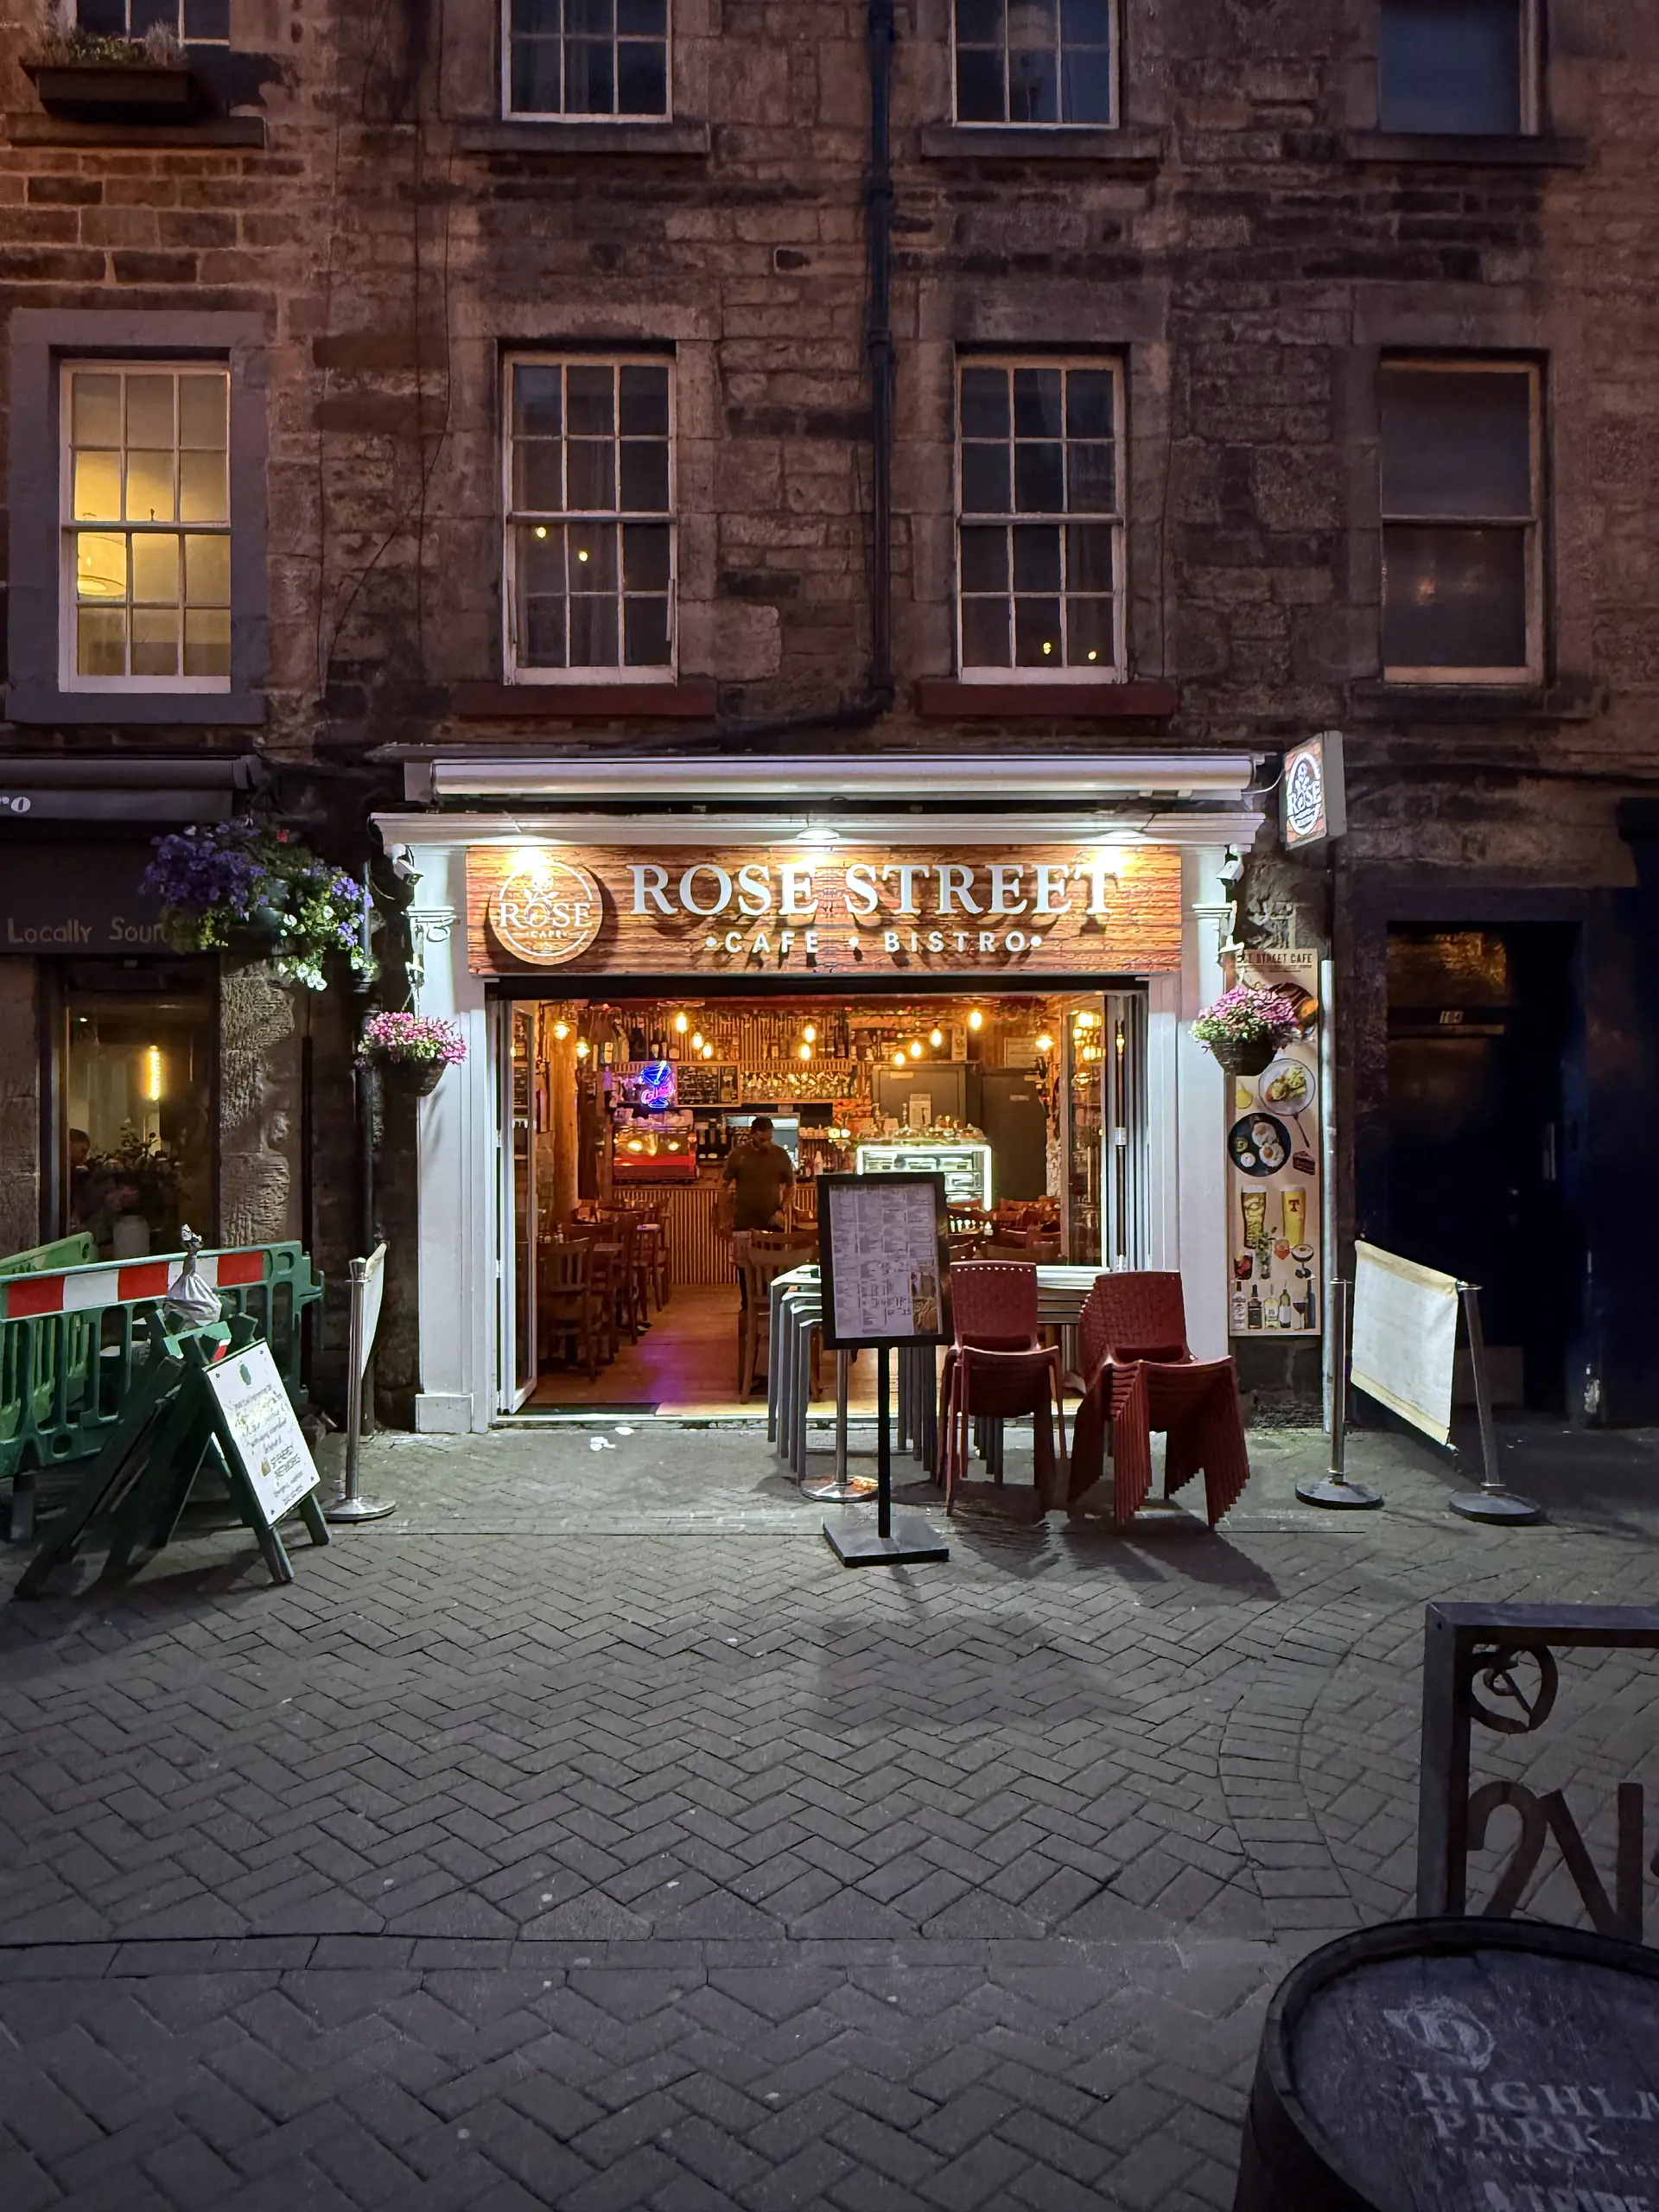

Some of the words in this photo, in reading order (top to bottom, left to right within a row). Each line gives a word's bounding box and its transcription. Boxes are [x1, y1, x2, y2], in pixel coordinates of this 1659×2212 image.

[1287, 780, 1323, 817] ROSE
[628, 863, 819, 916] ROSE
[844, 863, 1118, 915] STREET
[499, 902, 593, 929] ROSE
[7, 917, 92, 944] Locally
[725, 931, 819, 953] CAFE
[883, 931, 1026, 952] BISTRO
[1288, 1198, 1300, 1212] T
[1427, 2106, 1620, 2158] PARK
